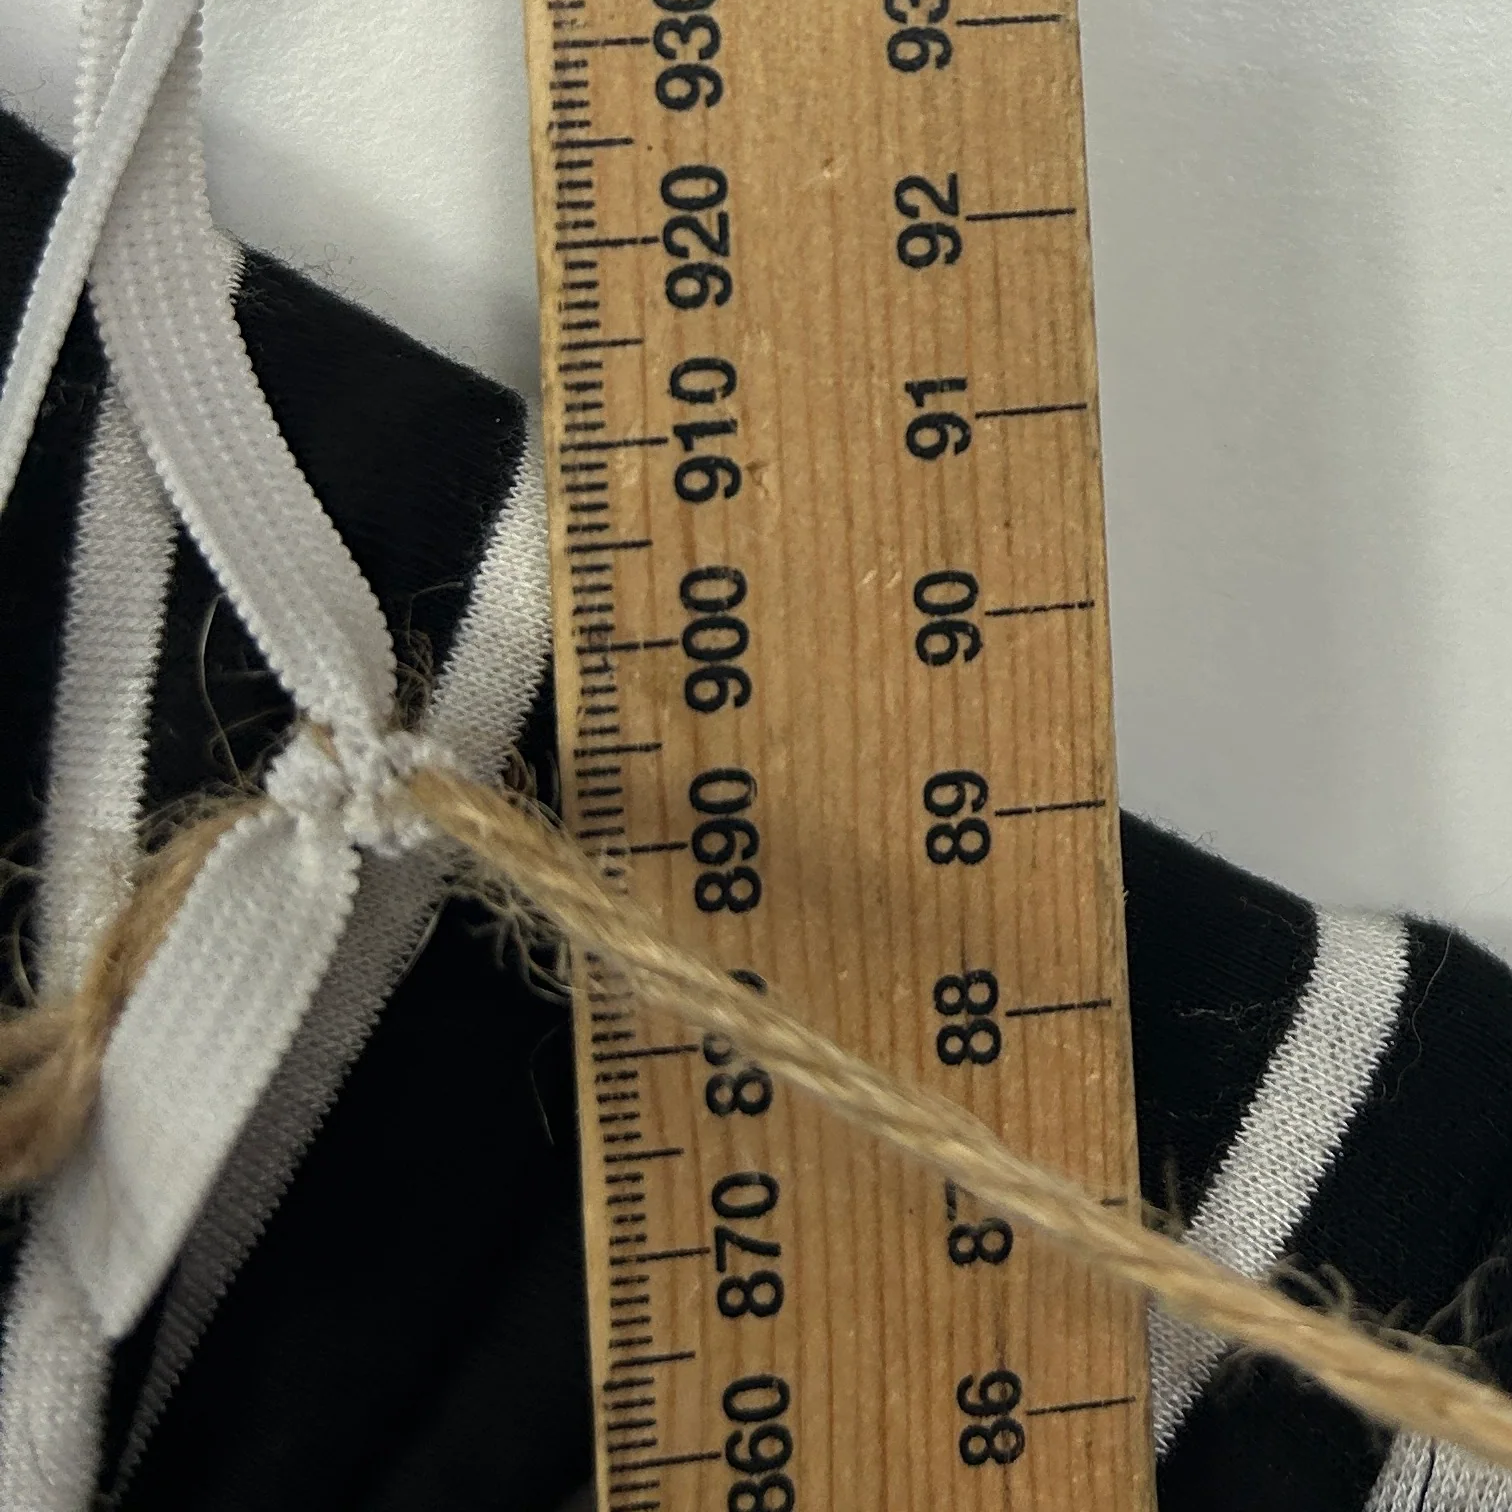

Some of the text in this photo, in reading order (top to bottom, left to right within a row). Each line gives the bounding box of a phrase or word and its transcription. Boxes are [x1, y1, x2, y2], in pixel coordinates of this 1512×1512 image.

[659, 164, 733, 312] 920
[893, 172, 963, 270] 92
[667, 358, 742, 506] 910
[903, 376, 973, 462] 91
[679, 566, 752, 716] 900
[913, 570, 984, 668] 90
[689, 767, 762, 914] 890
[923, 769, 992, 868] 89
[932, 968, 1003, 1068] 88
[711, 1171, 785, 1327] 870
[721, 1373, 796, 1512] 860
[956, 1368, 1026, 1466] 86
